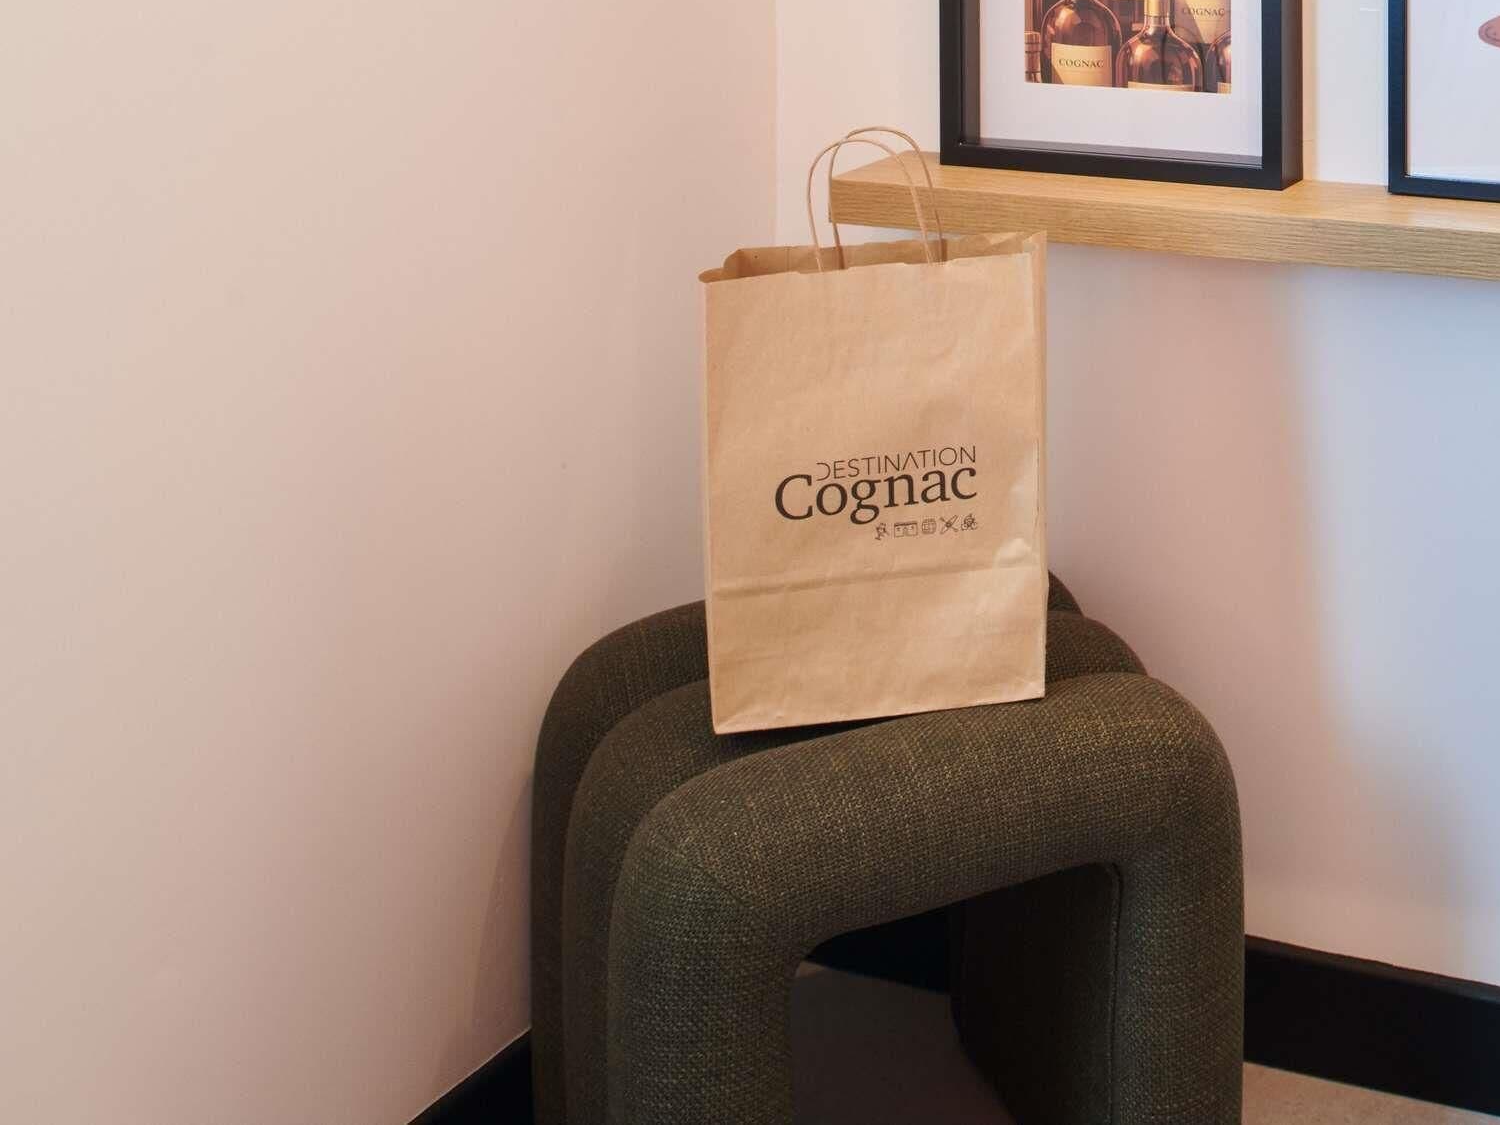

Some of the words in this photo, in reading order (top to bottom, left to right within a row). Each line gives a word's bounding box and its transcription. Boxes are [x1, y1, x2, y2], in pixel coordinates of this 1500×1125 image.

[1182, 7, 1226, 17] COGNAC
[1058, 58, 1104, 68] COGNAC
[816, 445, 976, 481] DESTINATION
[775, 467, 978, 525] Cognac
